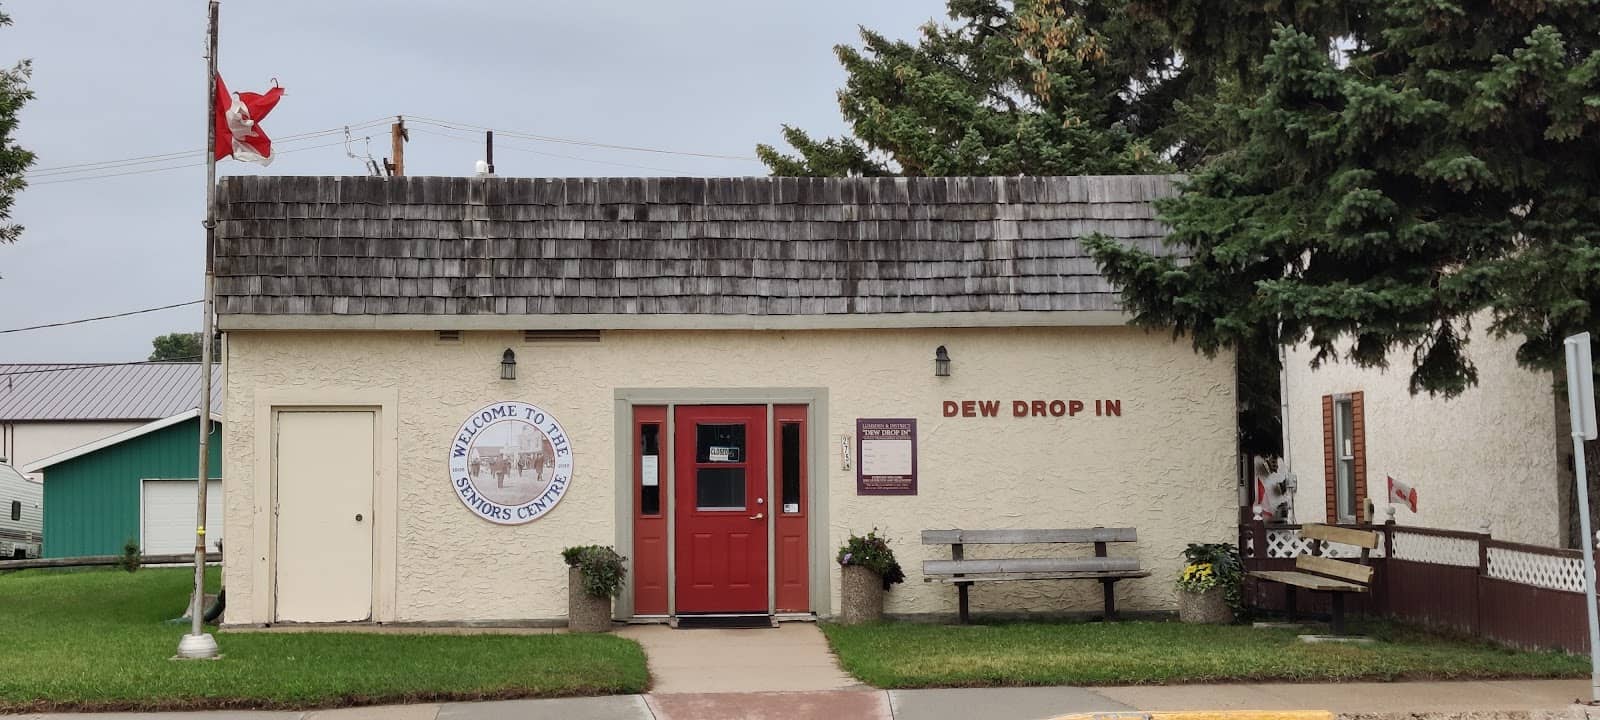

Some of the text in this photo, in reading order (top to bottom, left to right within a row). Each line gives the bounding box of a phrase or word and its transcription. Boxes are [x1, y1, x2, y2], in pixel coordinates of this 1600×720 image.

[942, 399, 1122, 418] DEW DROP IN
[453, 405, 569, 459] WELCOME TO THE
[711, 448, 729, 456] CLOSED
[456, 474, 567, 520] SENIORS CENTRE
